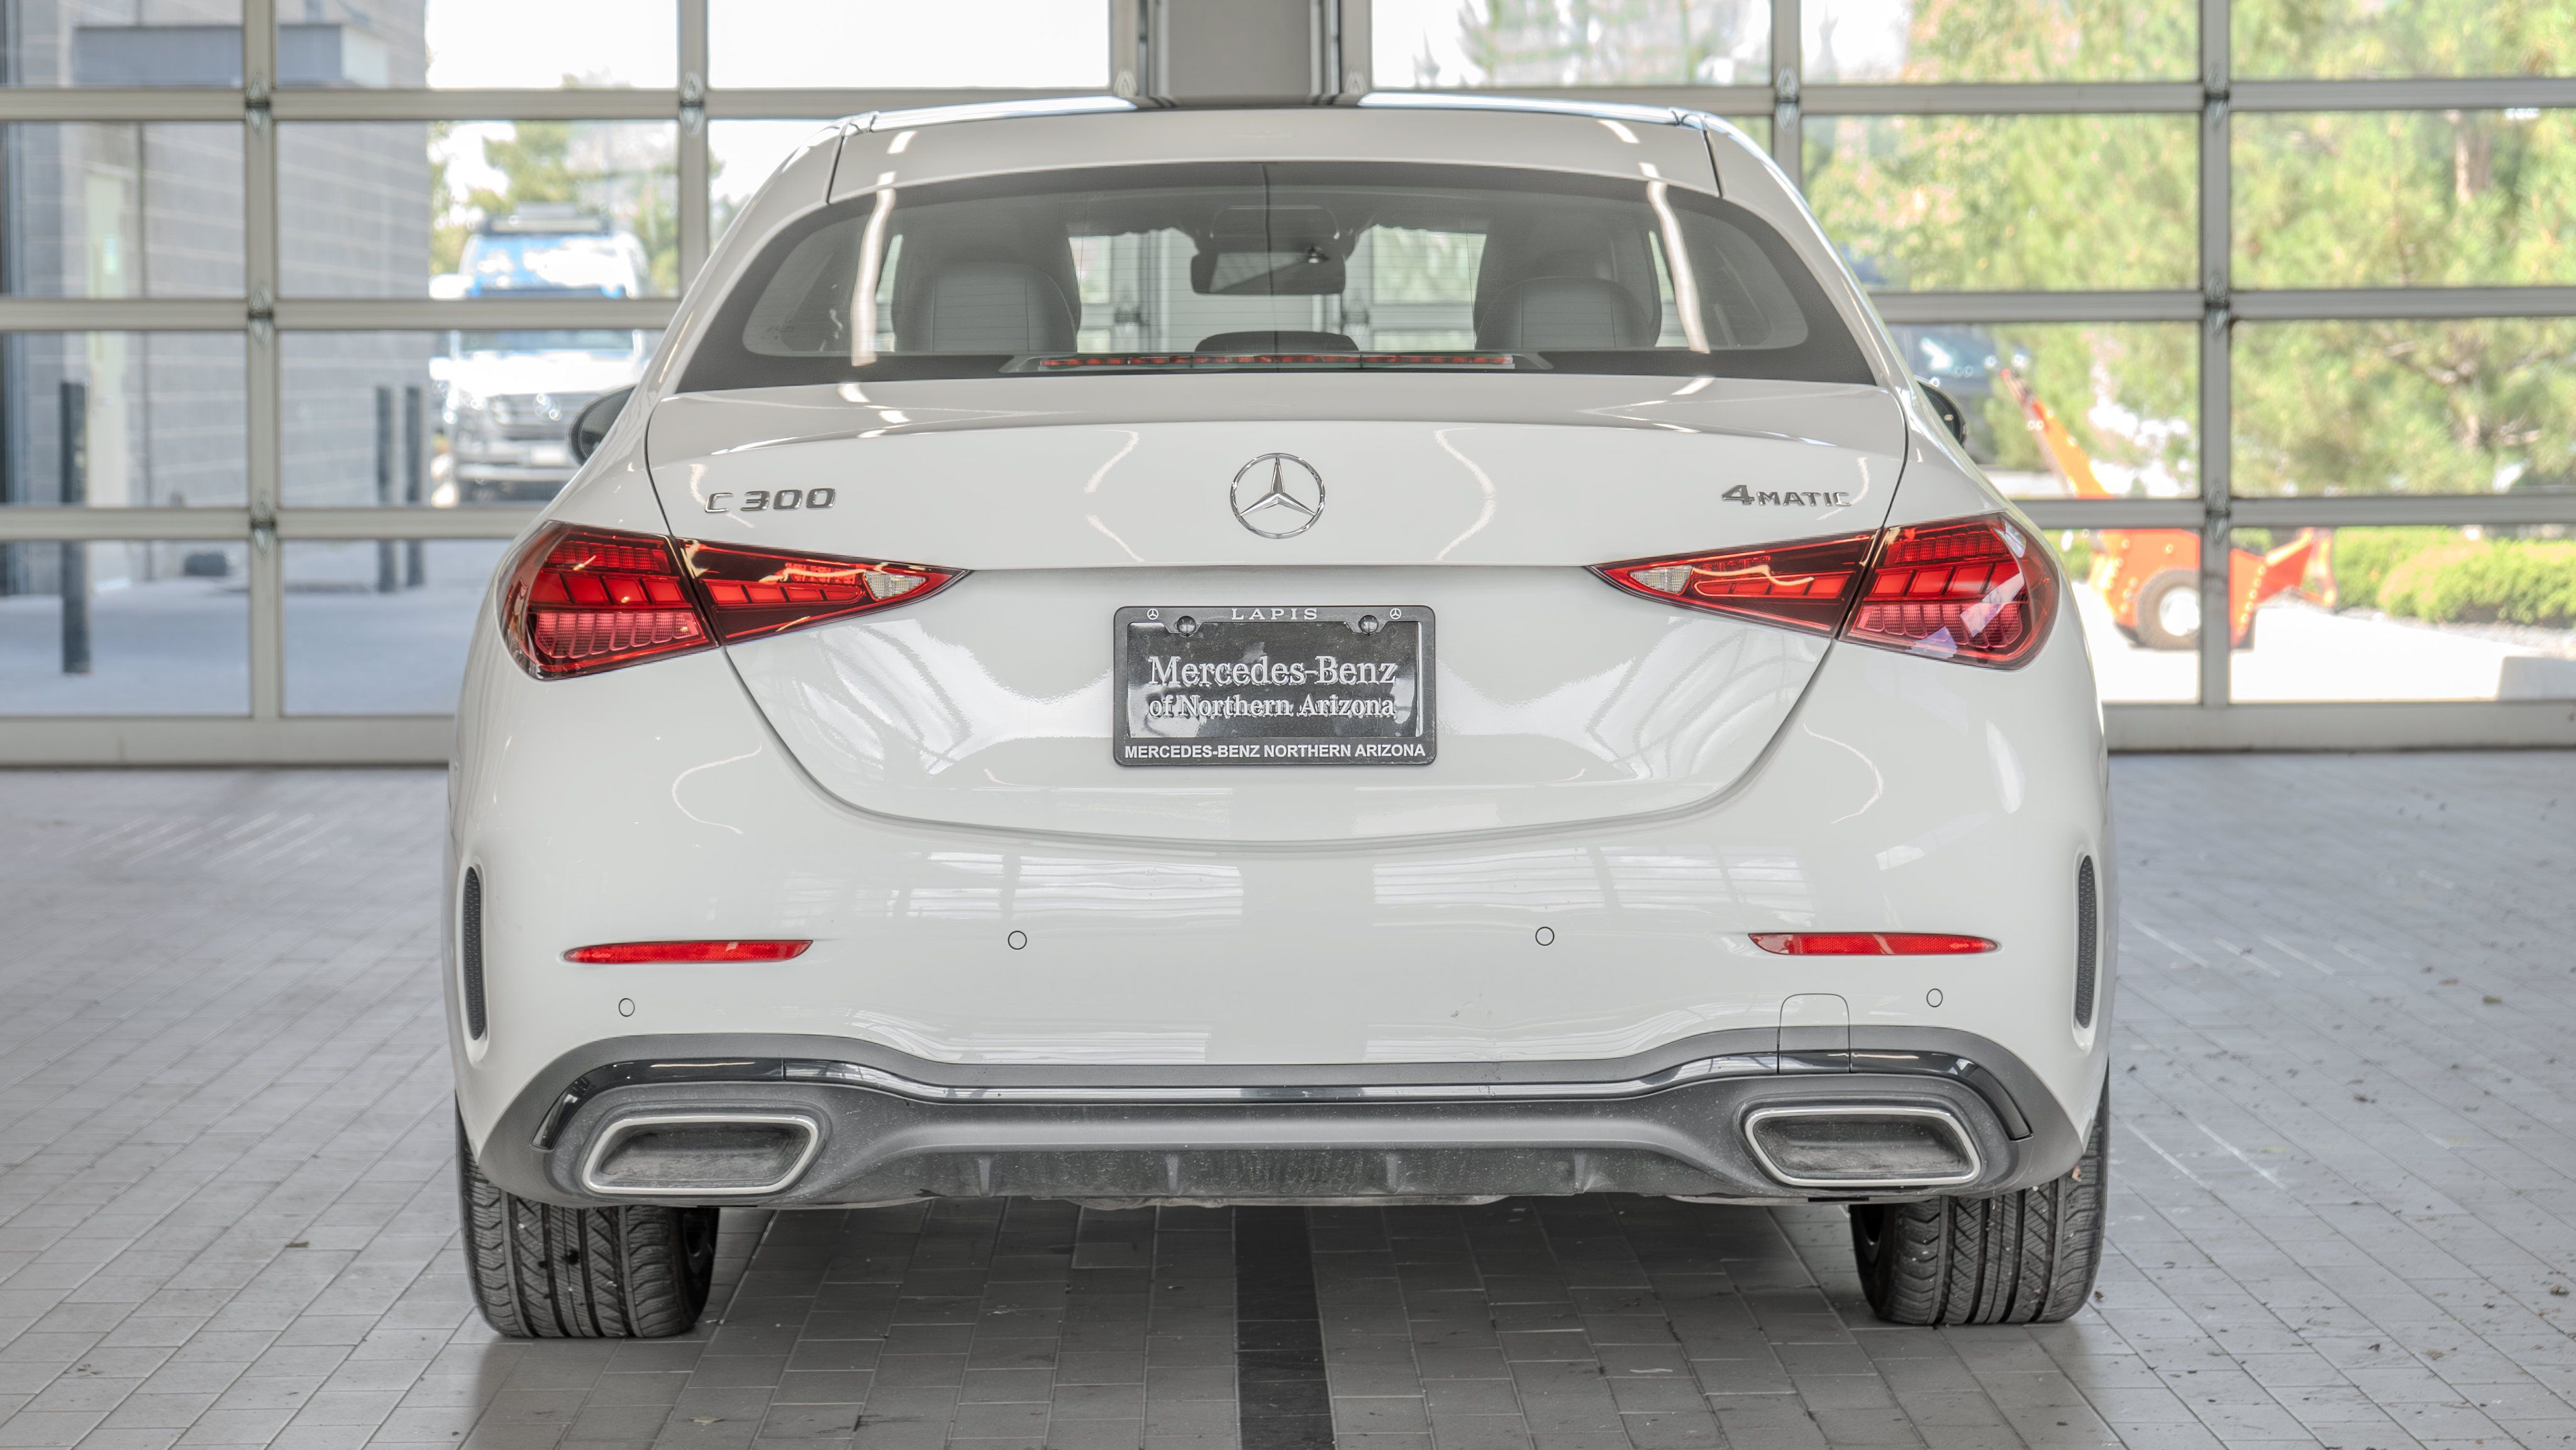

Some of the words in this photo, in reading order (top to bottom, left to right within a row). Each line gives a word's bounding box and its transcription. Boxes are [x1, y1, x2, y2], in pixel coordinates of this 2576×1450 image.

[704, 492, 734, 513] C
[740, 488, 836, 511] 300
[1721, 484, 1853, 507] 4MATIC
[1231, 608, 1318, 620] LAPIS
[1148, 655, 1397, 686] Mercedes-Benz
[1148, 694, 1175, 718] of
[1179, 694, 1293, 718] Northern
[1297, 694, 1396, 718] Arizona
[1124, 745, 1260, 759] MERCEDES-BENZ
[1263, 744, 1352, 757] NORTHERN
[1354, 744, 1426, 757] ARIZONA
